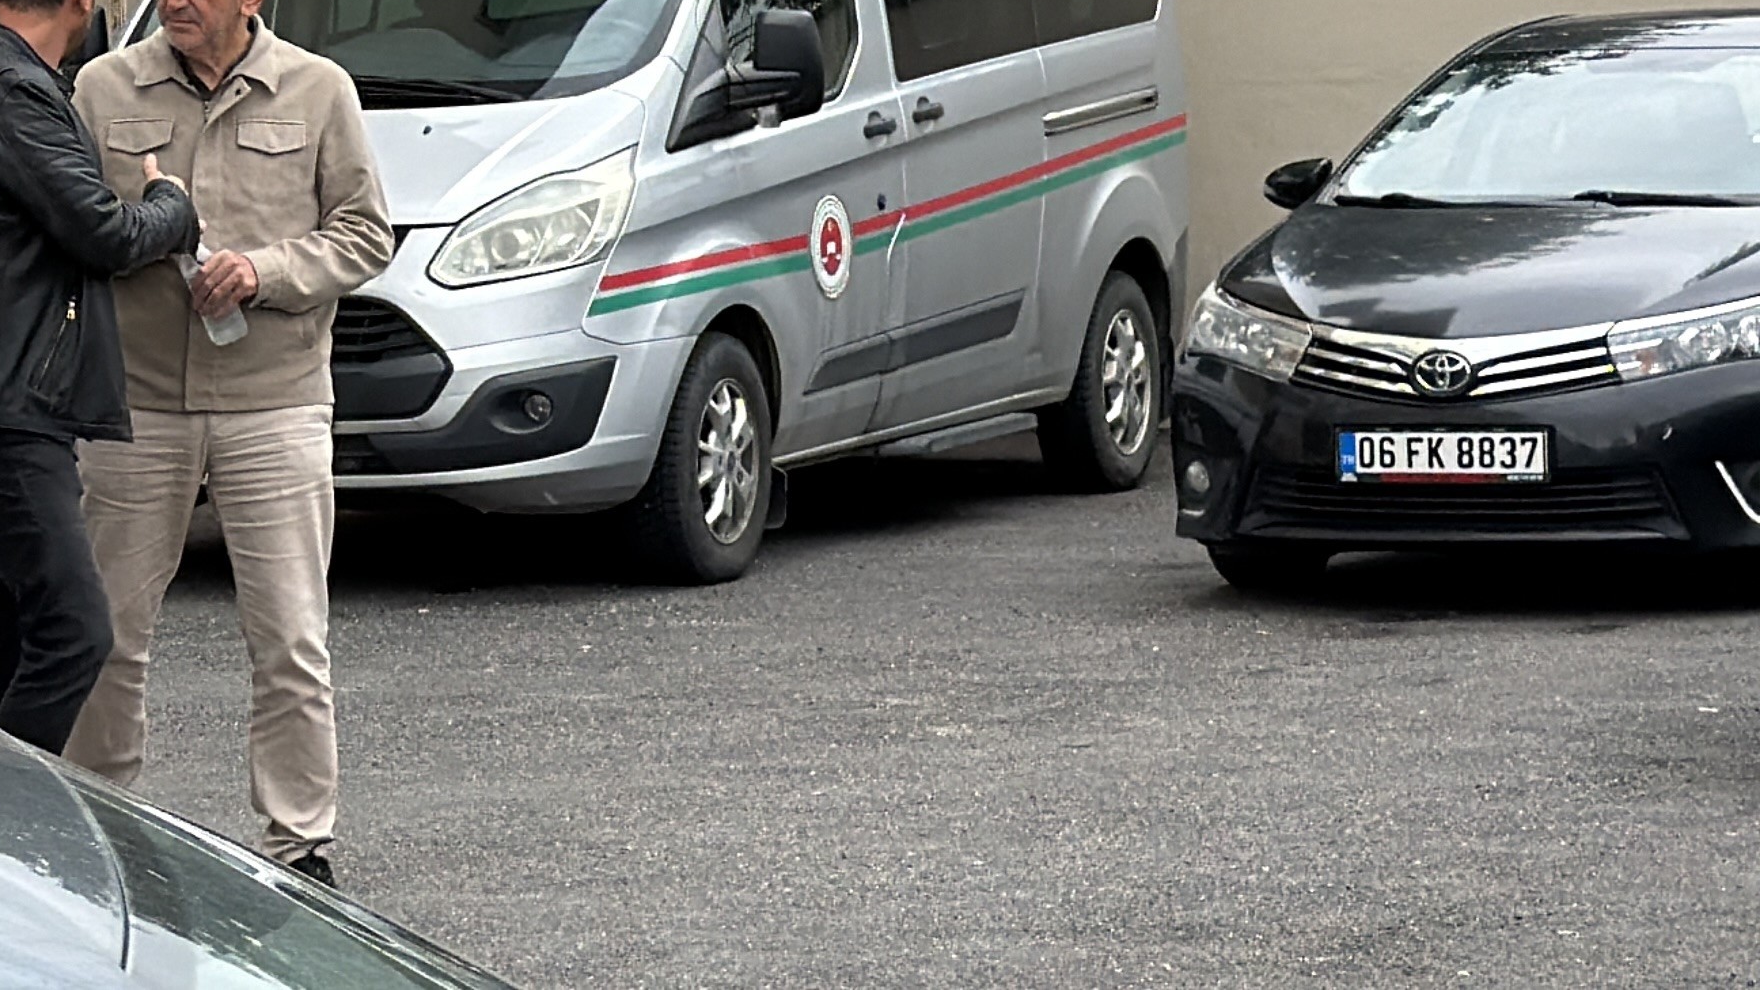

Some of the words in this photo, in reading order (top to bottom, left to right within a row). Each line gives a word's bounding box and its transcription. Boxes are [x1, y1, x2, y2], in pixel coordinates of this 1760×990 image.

[1359, 436, 1395, 469] 06
[1406, 436, 1445, 469] FK
[1456, 436, 1539, 469] 8837
